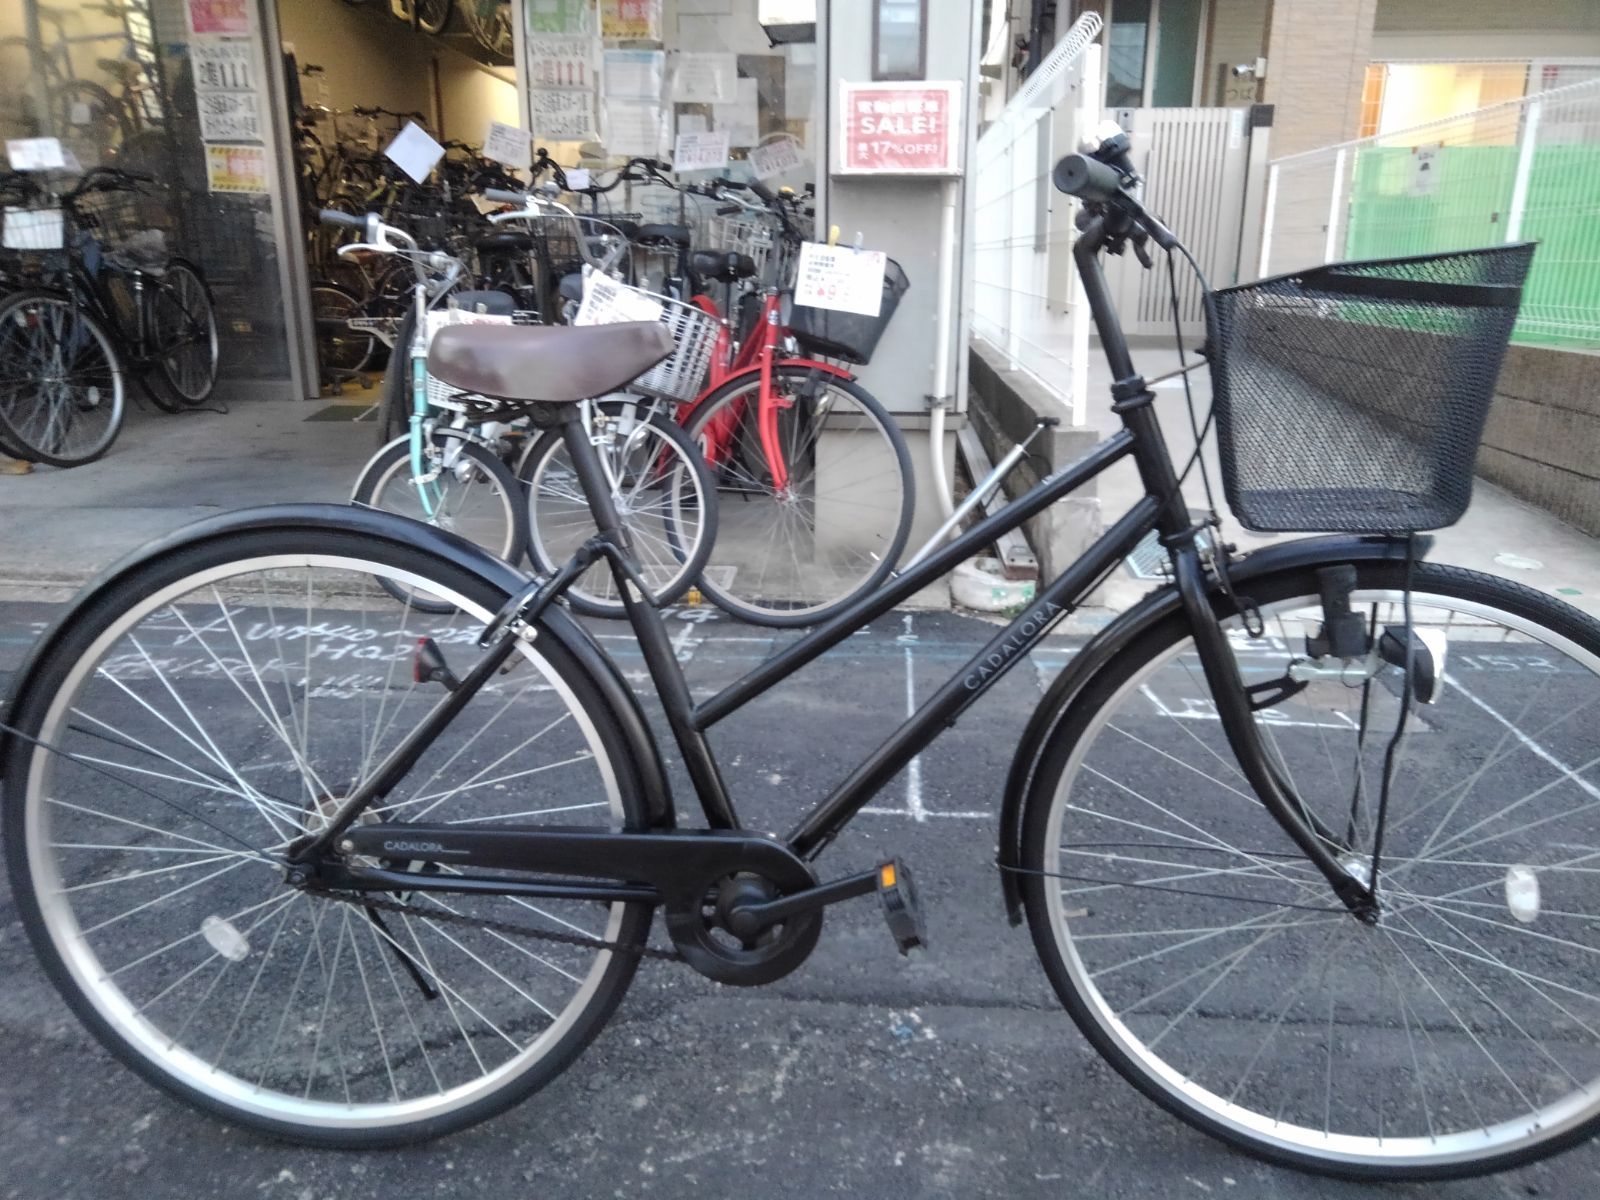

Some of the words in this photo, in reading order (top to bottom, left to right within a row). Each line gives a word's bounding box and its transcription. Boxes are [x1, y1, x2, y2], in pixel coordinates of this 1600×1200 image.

[860, 116, 937, 135] SALE!
[963, 601, 1063, 690] CADALORA
[384, 840, 444, 851] CADALORA
